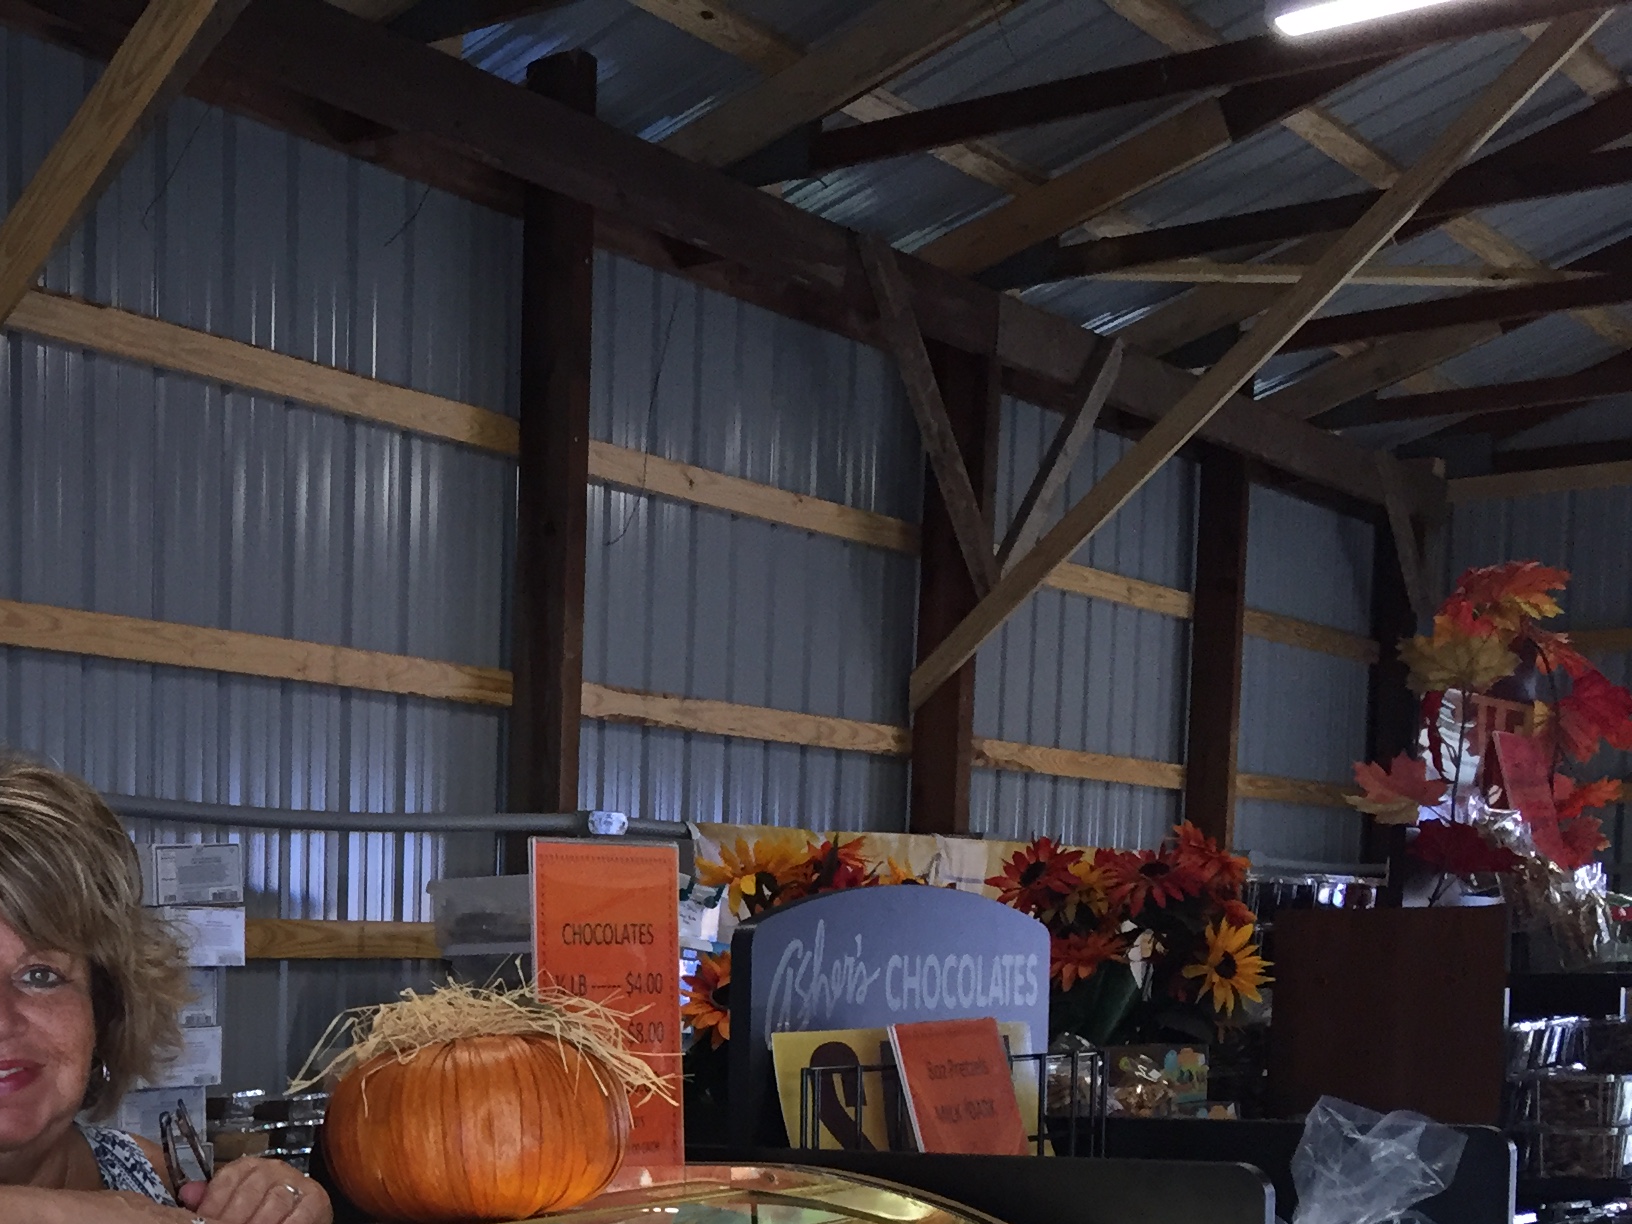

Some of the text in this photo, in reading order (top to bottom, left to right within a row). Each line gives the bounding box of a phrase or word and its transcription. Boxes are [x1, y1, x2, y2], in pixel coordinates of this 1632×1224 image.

[561, 922, 655, 946] CHOCOLATES
[625, 970, 663, 998] $4.00
[885, 953, 1040, 1012] CHOCOLATES
